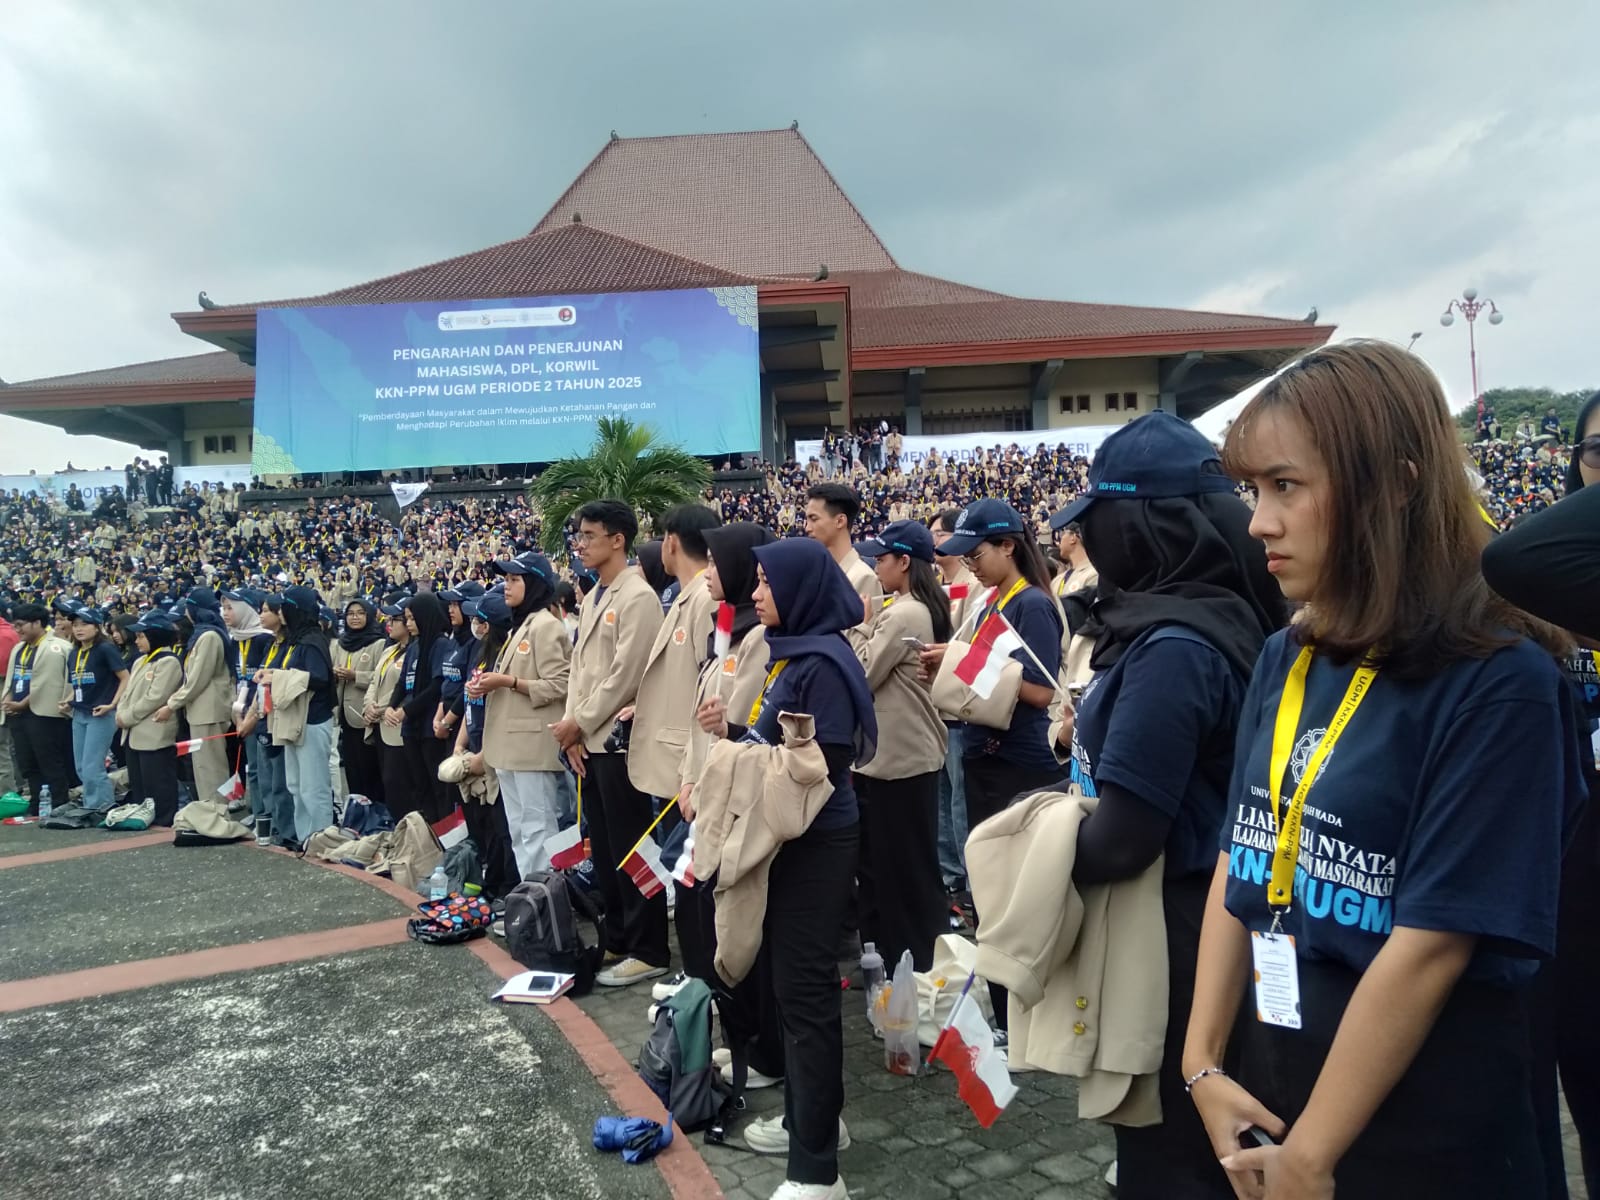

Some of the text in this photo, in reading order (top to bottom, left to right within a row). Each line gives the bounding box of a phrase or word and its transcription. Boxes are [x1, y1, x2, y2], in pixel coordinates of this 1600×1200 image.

[393, 339, 623, 361] PENGARAHAN DAN PENERJUNAN
[417, 360, 600, 378] MAHASISWA, DPL, KORWIL
[375, 376, 642, 399] KKN-PPM UGM PERIODE 2 TAHUN 2025
[427, 408, 475, 419] Masyarakat
[476, 407, 503, 416] dalam
[505, 405, 558, 415] Mewujudkan
[560, 403, 605, 412] Ketahanan
[607, 402, 638, 412] Pangan
[640, 401, 657, 409] dan
[396, 421, 448, 432] Menghadapi
[449, 419, 496, 428] Perubahan
[519, 416, 551, 425] melalui
[552, 414, 593, 424] KKN-PPM
[898, 448, 976, 464] MENABDI
[1350, 675, 1369, 703] UGM
[1315, 808, 1343, 828] MADA
[1236, 804, 1279, 833] LIAH
[1315, 834, 1396, 875] NYATA
[1282, 813, 1300, 861] KKN-PPM
[1313, 858, 1395, 897] MASYARAKAT
[1306, 878, 1393, 935] UGM
